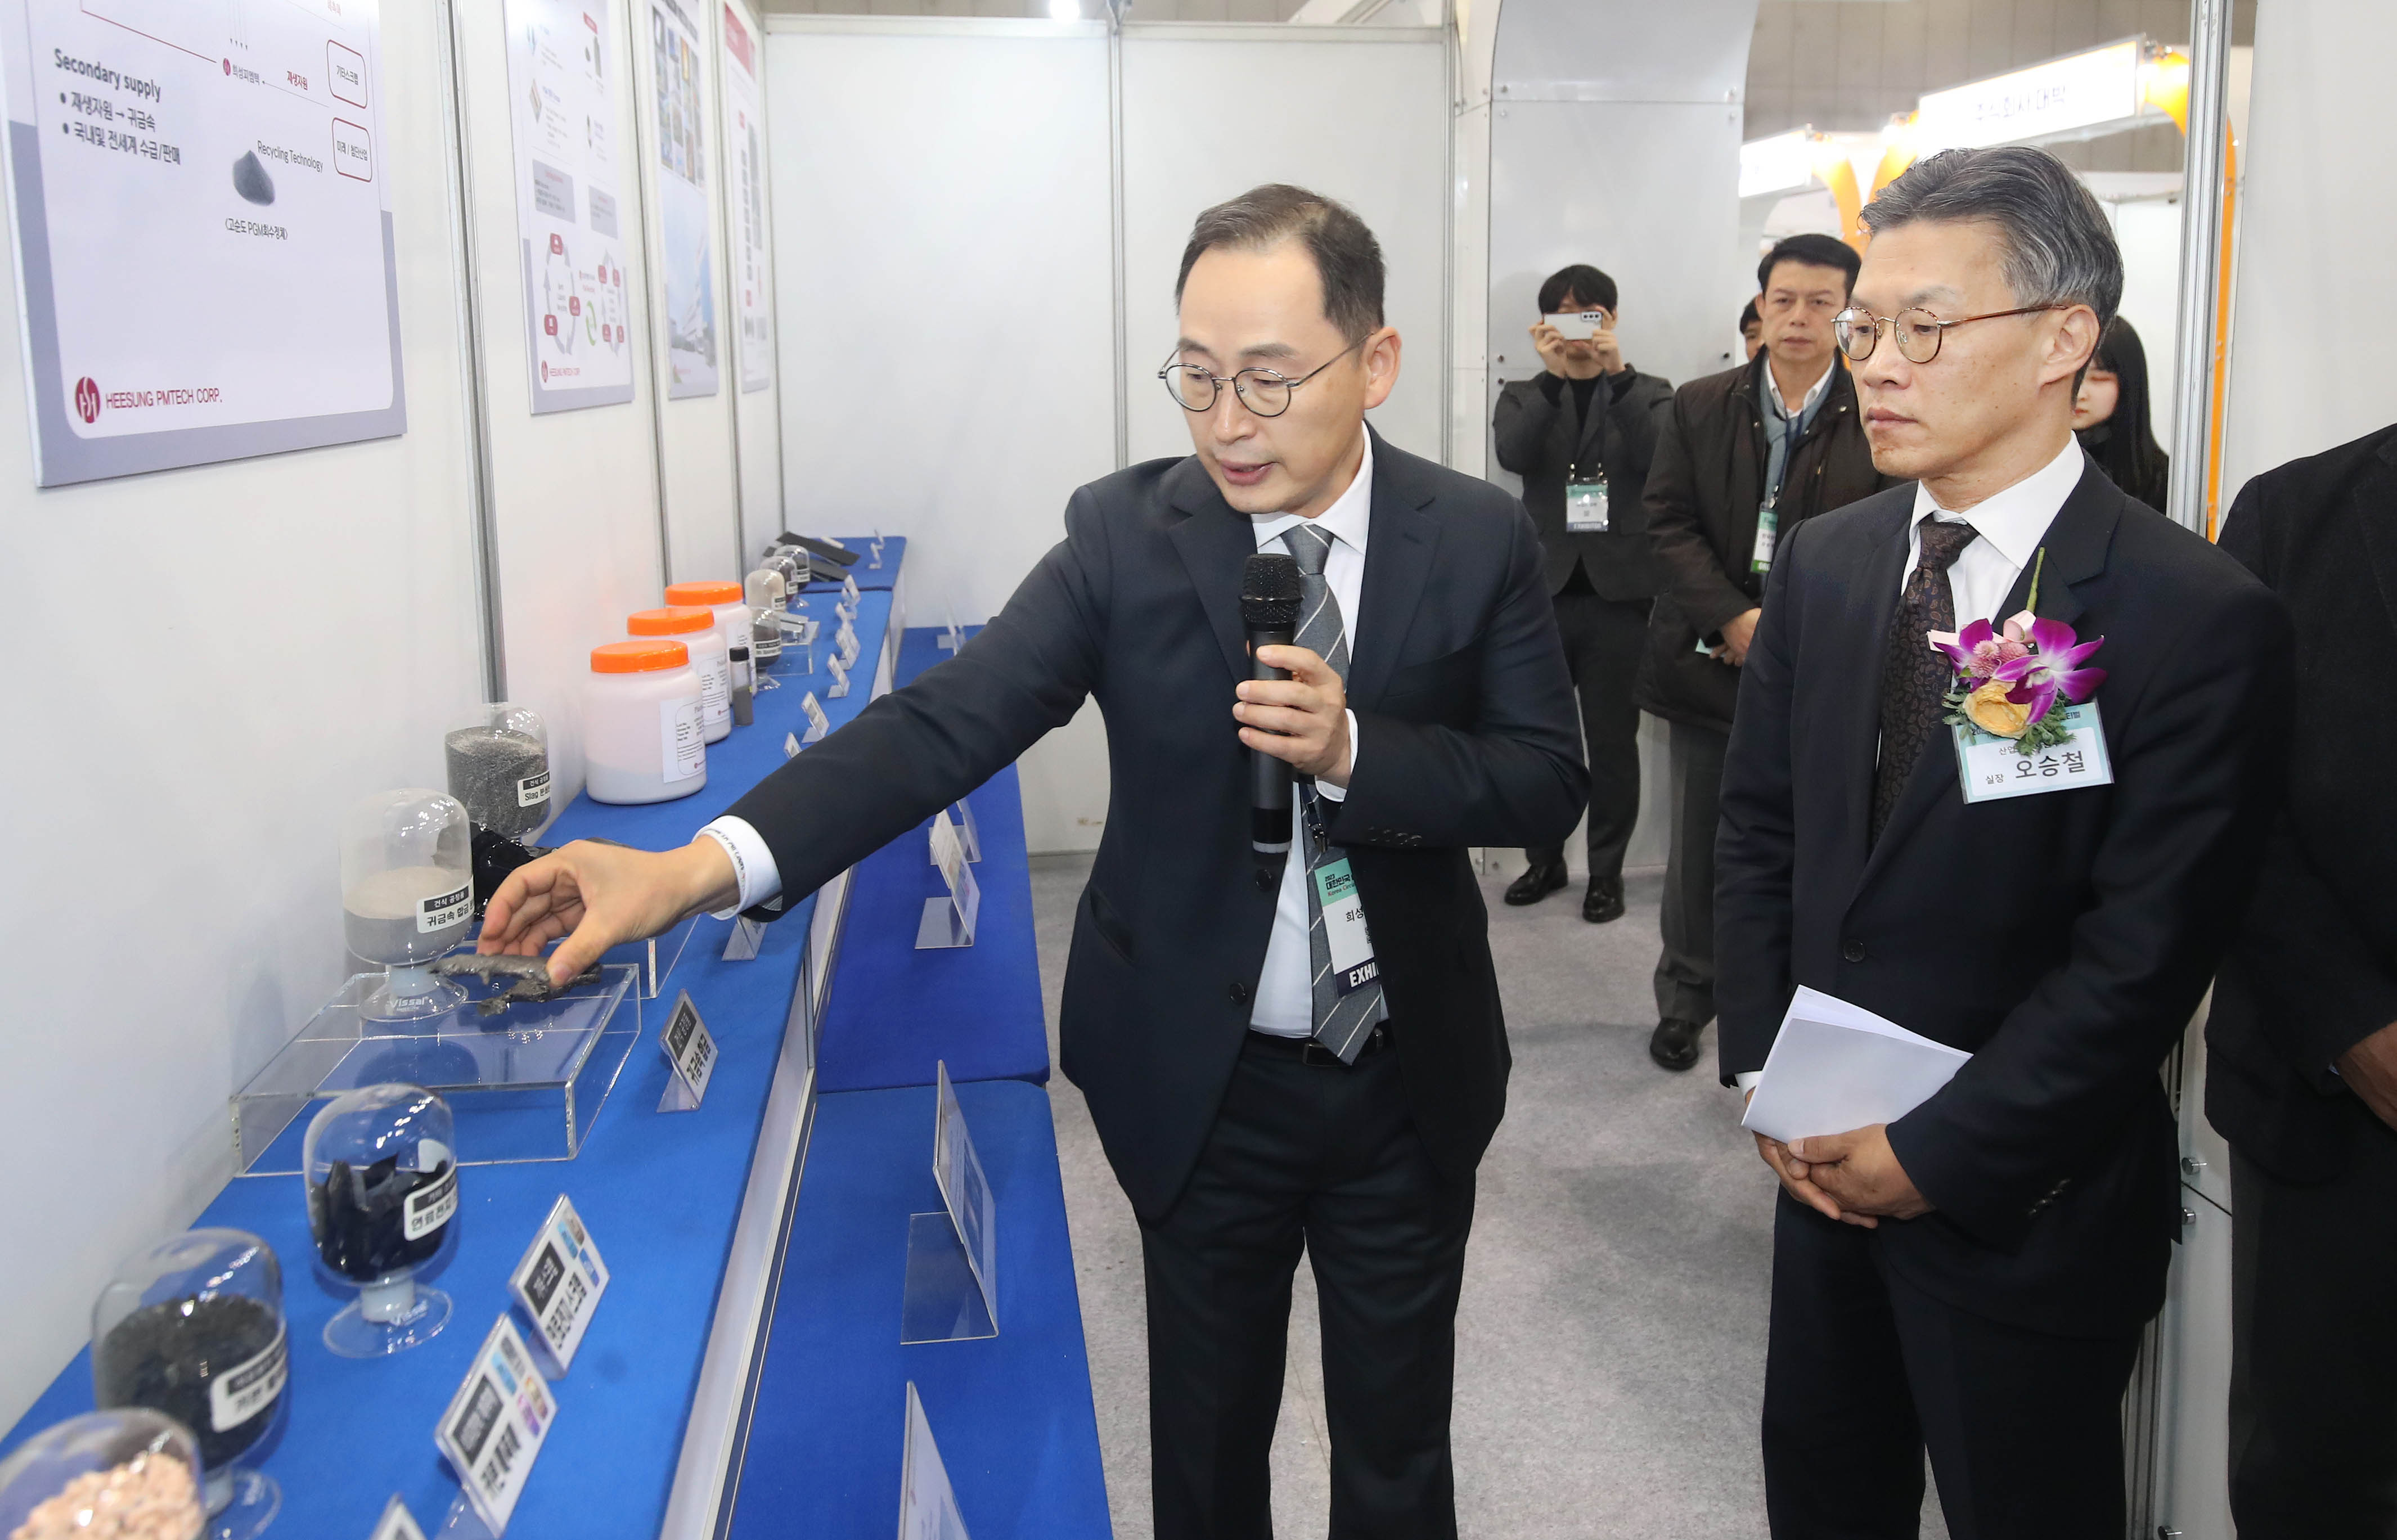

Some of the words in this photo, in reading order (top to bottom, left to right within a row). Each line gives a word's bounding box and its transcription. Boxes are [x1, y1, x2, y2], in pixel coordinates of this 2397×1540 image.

[55, 48, 120, 90] Secondary
[124, 75, 160, 103] supply
[287, 70, 308, 90] 재생자원
[71, 92, 113, 121] 재생자원
[128, 107, 155, 132] 귀금속
[74, 121, 105, 147] 국내및
[109, 130, 137, 155] 전세계
[257, 140, 289, 164] Recycling
[290, 150, 323, 173] Technology
[105, 391, 153, 409] HEESUNG
[156, 389, 194, 405] PMTECH
[196, 388, 222, 403] CORP.
[2016, 751, 2085, 778] 오승철
[1985, 774, 2004, 785] 실장
[525, 791, 538, 801] Slag
[1326, 874, 1350, 890] 대한민국
[1328, 888, 1342, 897] Korea
[427, 911, 455, 926] 귀금속
[457, 903, 469, 917] 합금
[434, 898, 447, 908] 건식
[1349, 962, 1379, 988] EXHI
[687, 1051, 705, 1086] 귀금속
[698, 1033, 711, 1062] 합금
